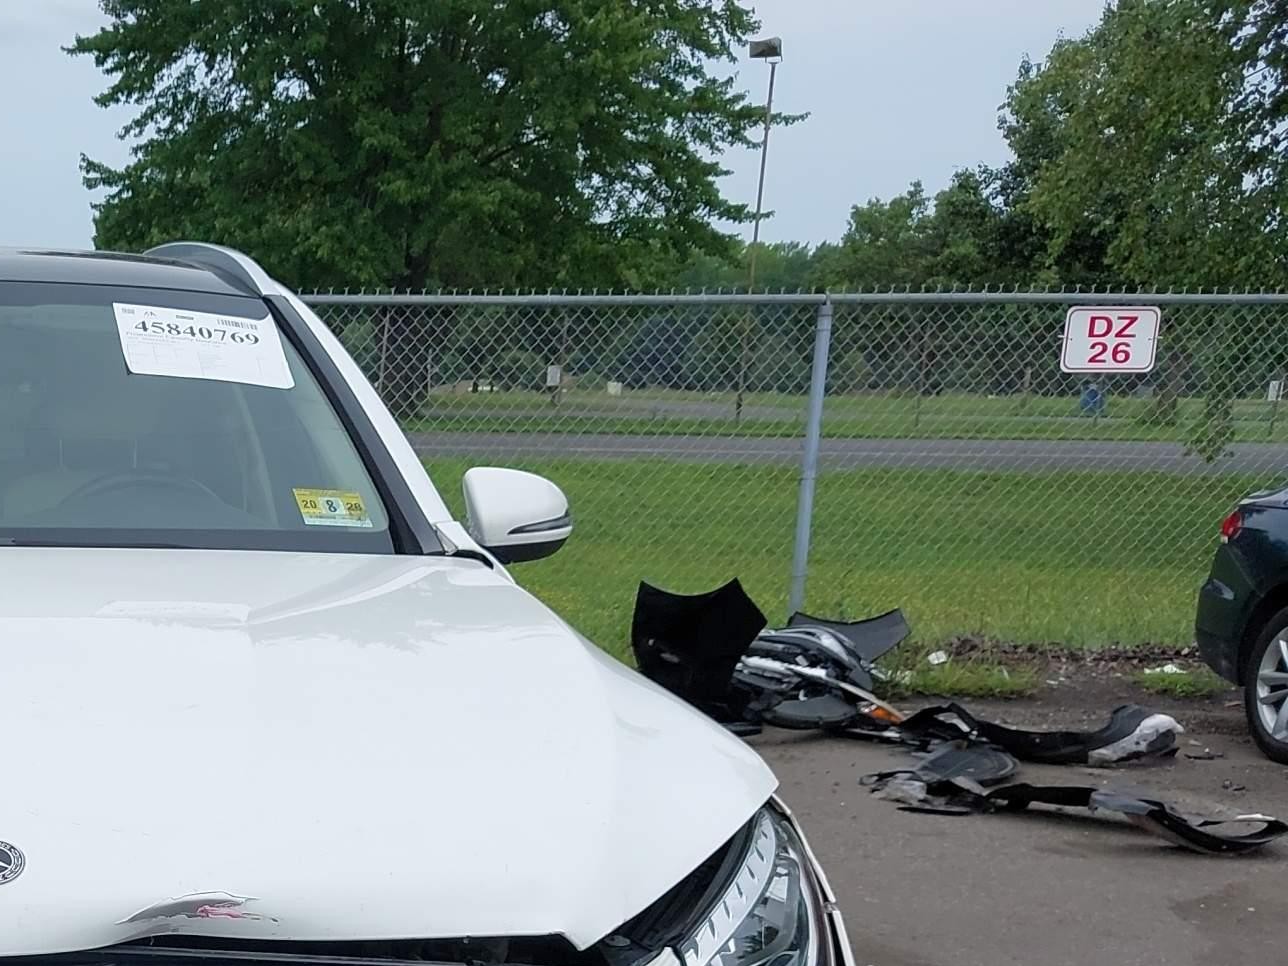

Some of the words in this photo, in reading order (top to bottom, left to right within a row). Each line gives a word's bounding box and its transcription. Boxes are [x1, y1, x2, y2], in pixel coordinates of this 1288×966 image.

[134, 320, 260, 345] 45840769
[1087, 316, 1139, 338] DZ
[1087, 341, 1131, 364] 26
[301, 499, 317, 509] 20
[325, 499, 338, 513] 8
